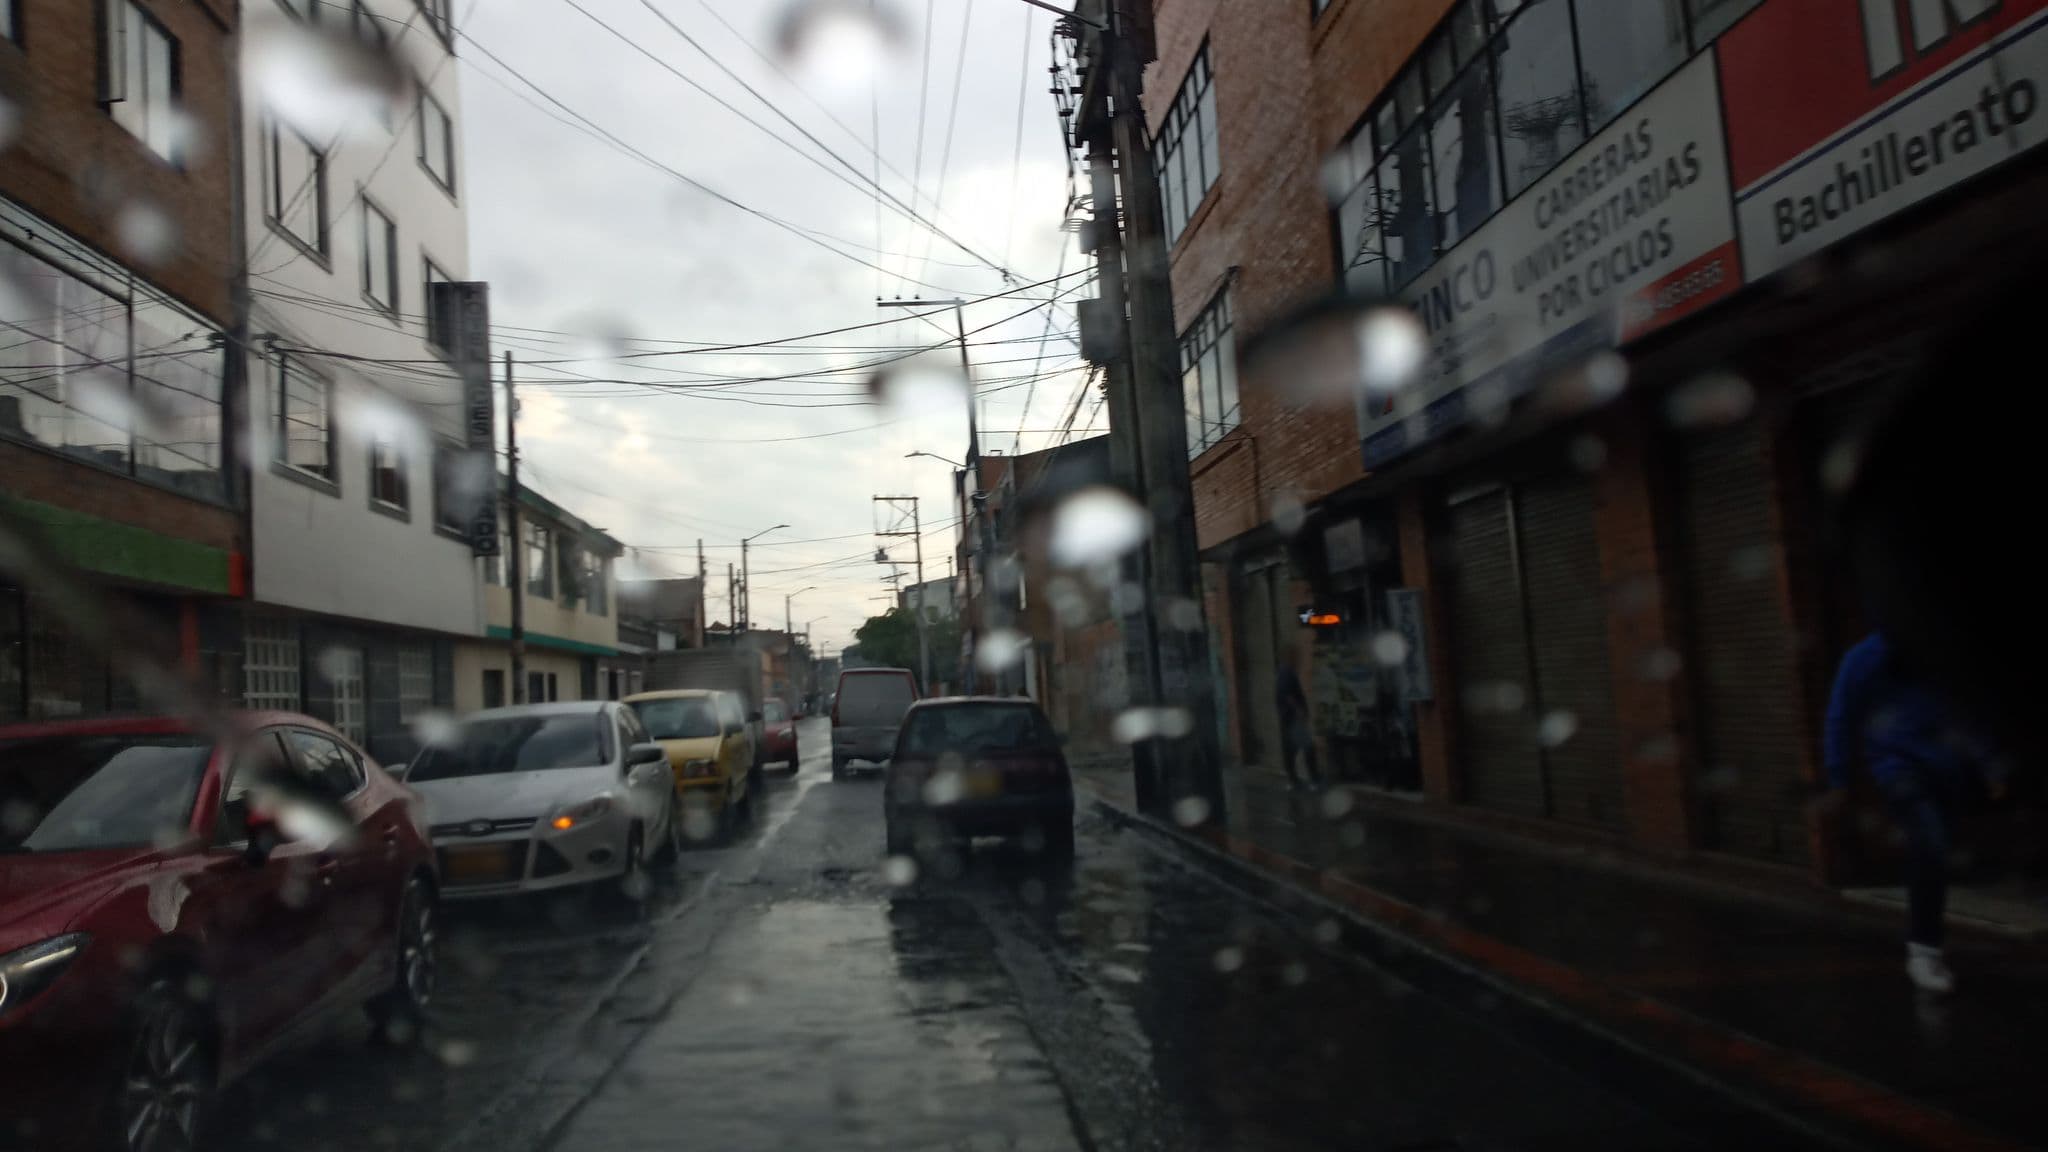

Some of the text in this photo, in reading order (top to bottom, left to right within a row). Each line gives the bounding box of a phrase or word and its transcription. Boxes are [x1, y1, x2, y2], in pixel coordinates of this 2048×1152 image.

[1512, 141, 1699, 293] UNIVERSITARIAS
[1535, 118, 1653, 231] CARRERAS
[1773, 77, 2037, 245] Bachillerato
[1538, 274, 1582, 325] POR
[1586, 217, 1674, 297] CICLOS
